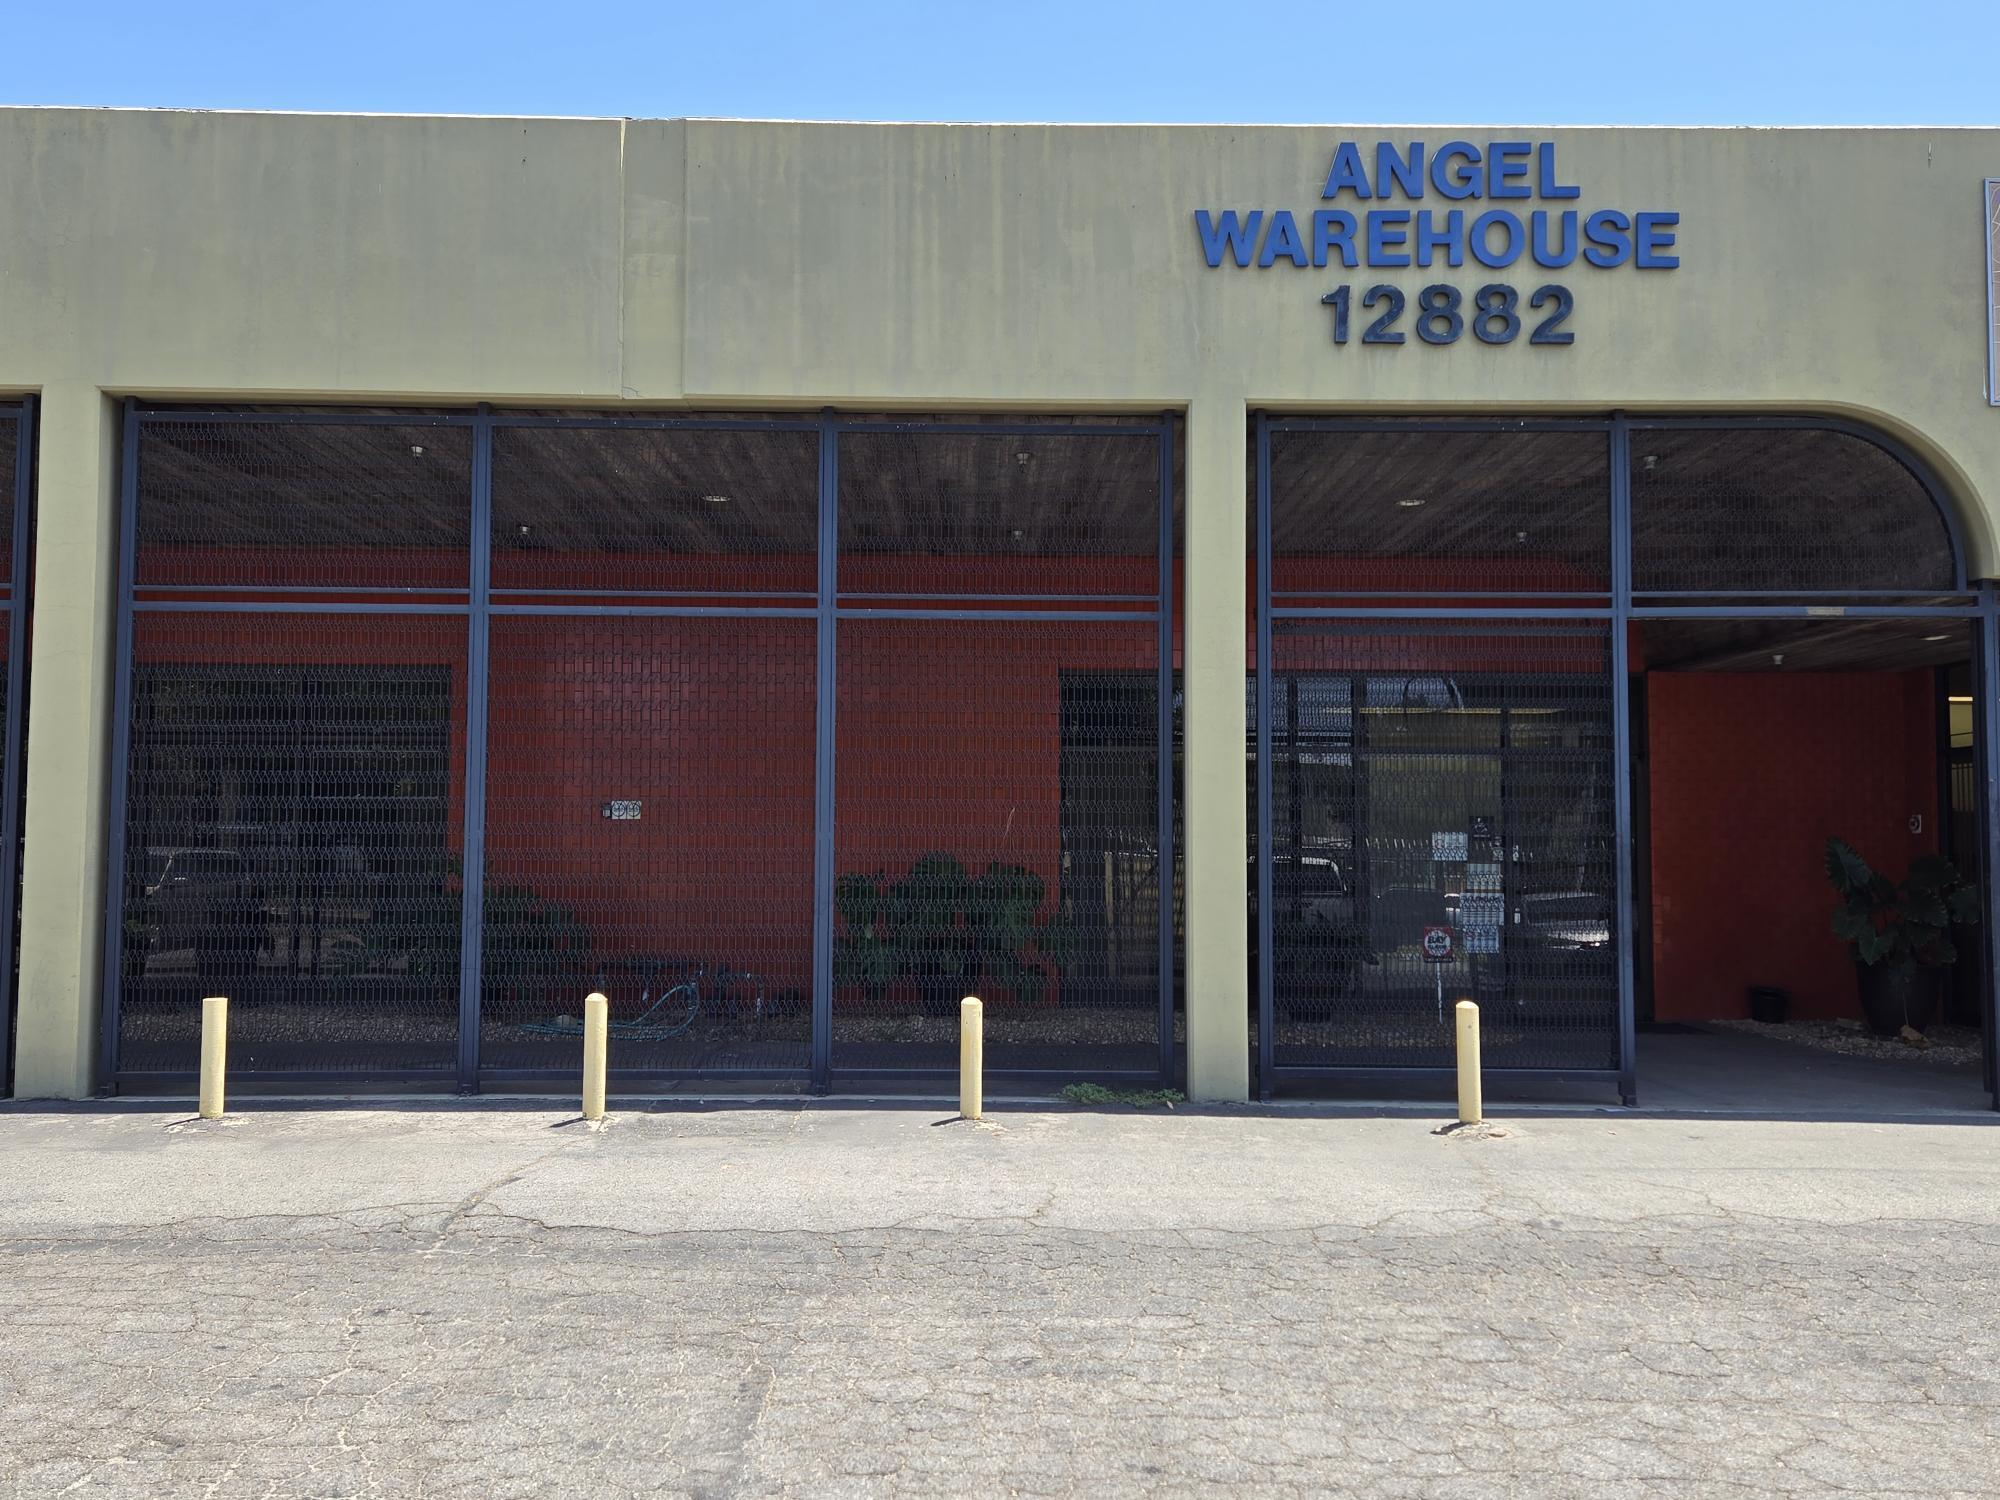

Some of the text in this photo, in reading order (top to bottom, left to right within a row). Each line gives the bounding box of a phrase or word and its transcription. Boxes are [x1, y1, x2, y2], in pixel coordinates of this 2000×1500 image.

[1321, 141, 1581, 200] ANGEL
[1195, 209, 1680, 269] WAREHOUSE
[1321, 284, 1575, 346] 12882
